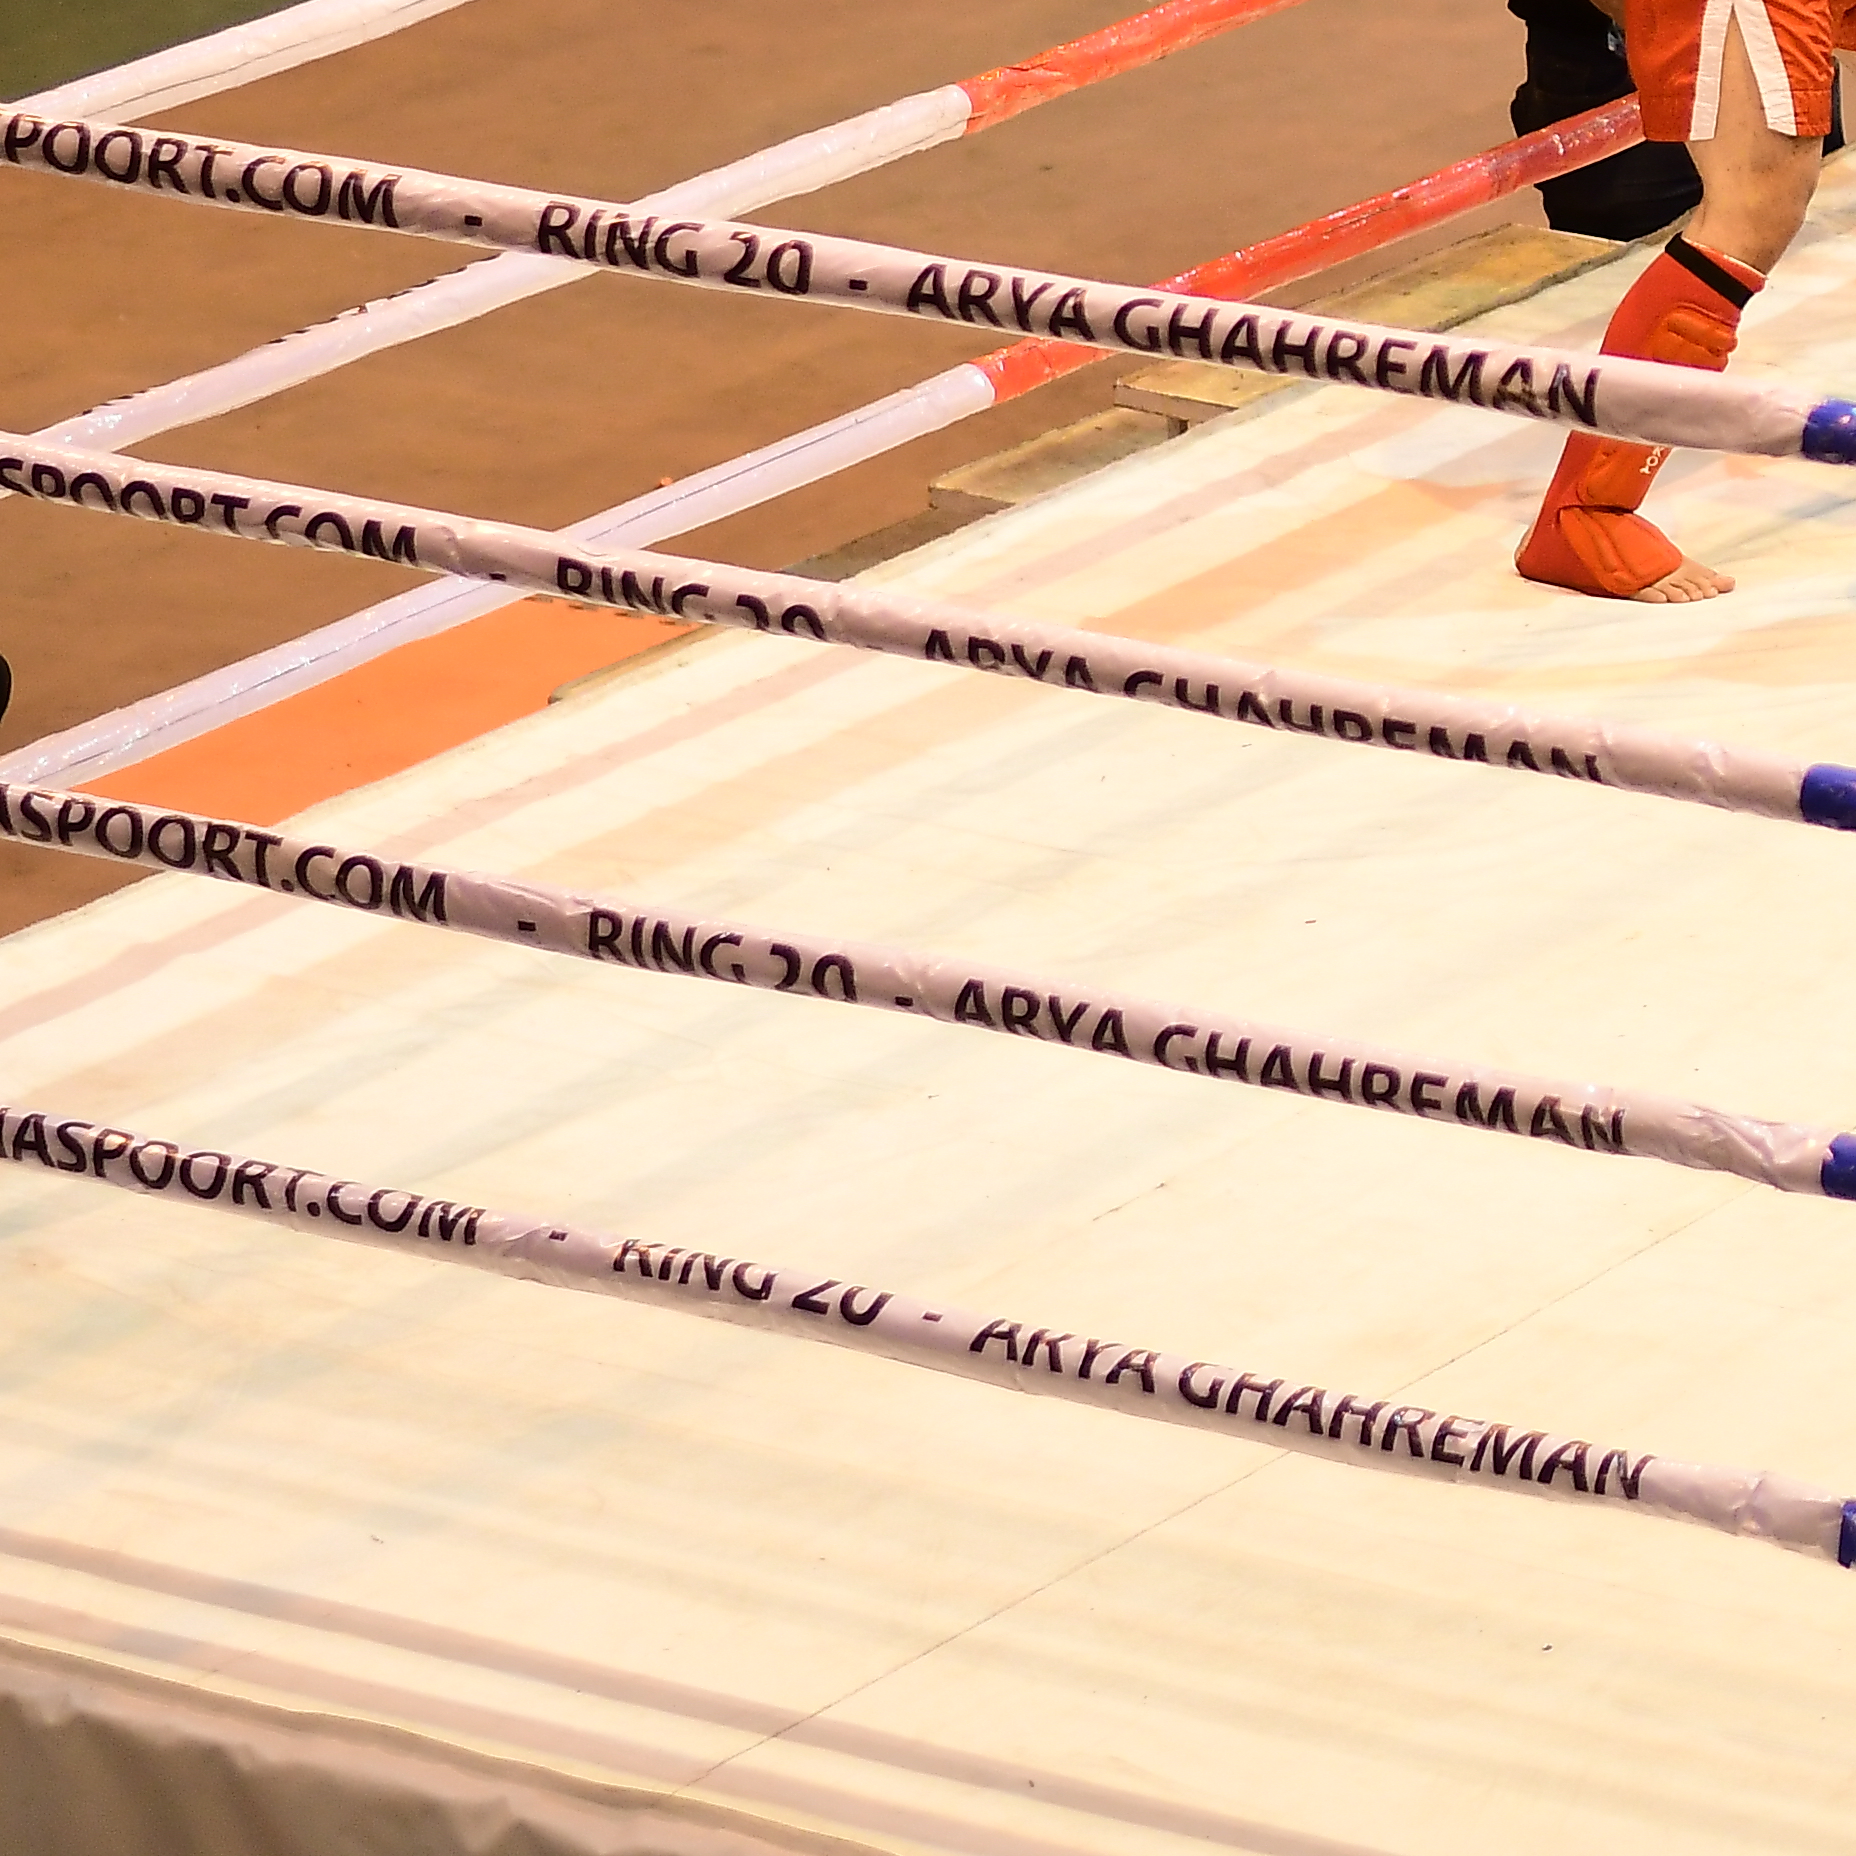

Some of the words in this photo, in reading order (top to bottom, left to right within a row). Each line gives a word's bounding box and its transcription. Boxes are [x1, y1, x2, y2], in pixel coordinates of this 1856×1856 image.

[537, 200, 706, 278] RING
[723, 228, 816, 296] 20
[906, 261, 1097, 341] ARYA
[1113, 296, 1603, 428] GHAHREMAN
[0, 457, 419, 568] SPOORTCOM
[0, 786, 448, 924] SPOORT.COM
[586, 907, 747, 985] RING
[767, 943, 859, 1004] 20
[952, 978, 1133, 1058] ARYA
[1150, 1022, 1628, 1154] GHAHREMAN
[0, 1106, 488, 1246] ASPOORT.COM
[610, 1237, 781, 1302] RING
[968, 1317, 1166, 1396] ARYA
[1176, 1361, 1658, 1501] GHAHREMAN
